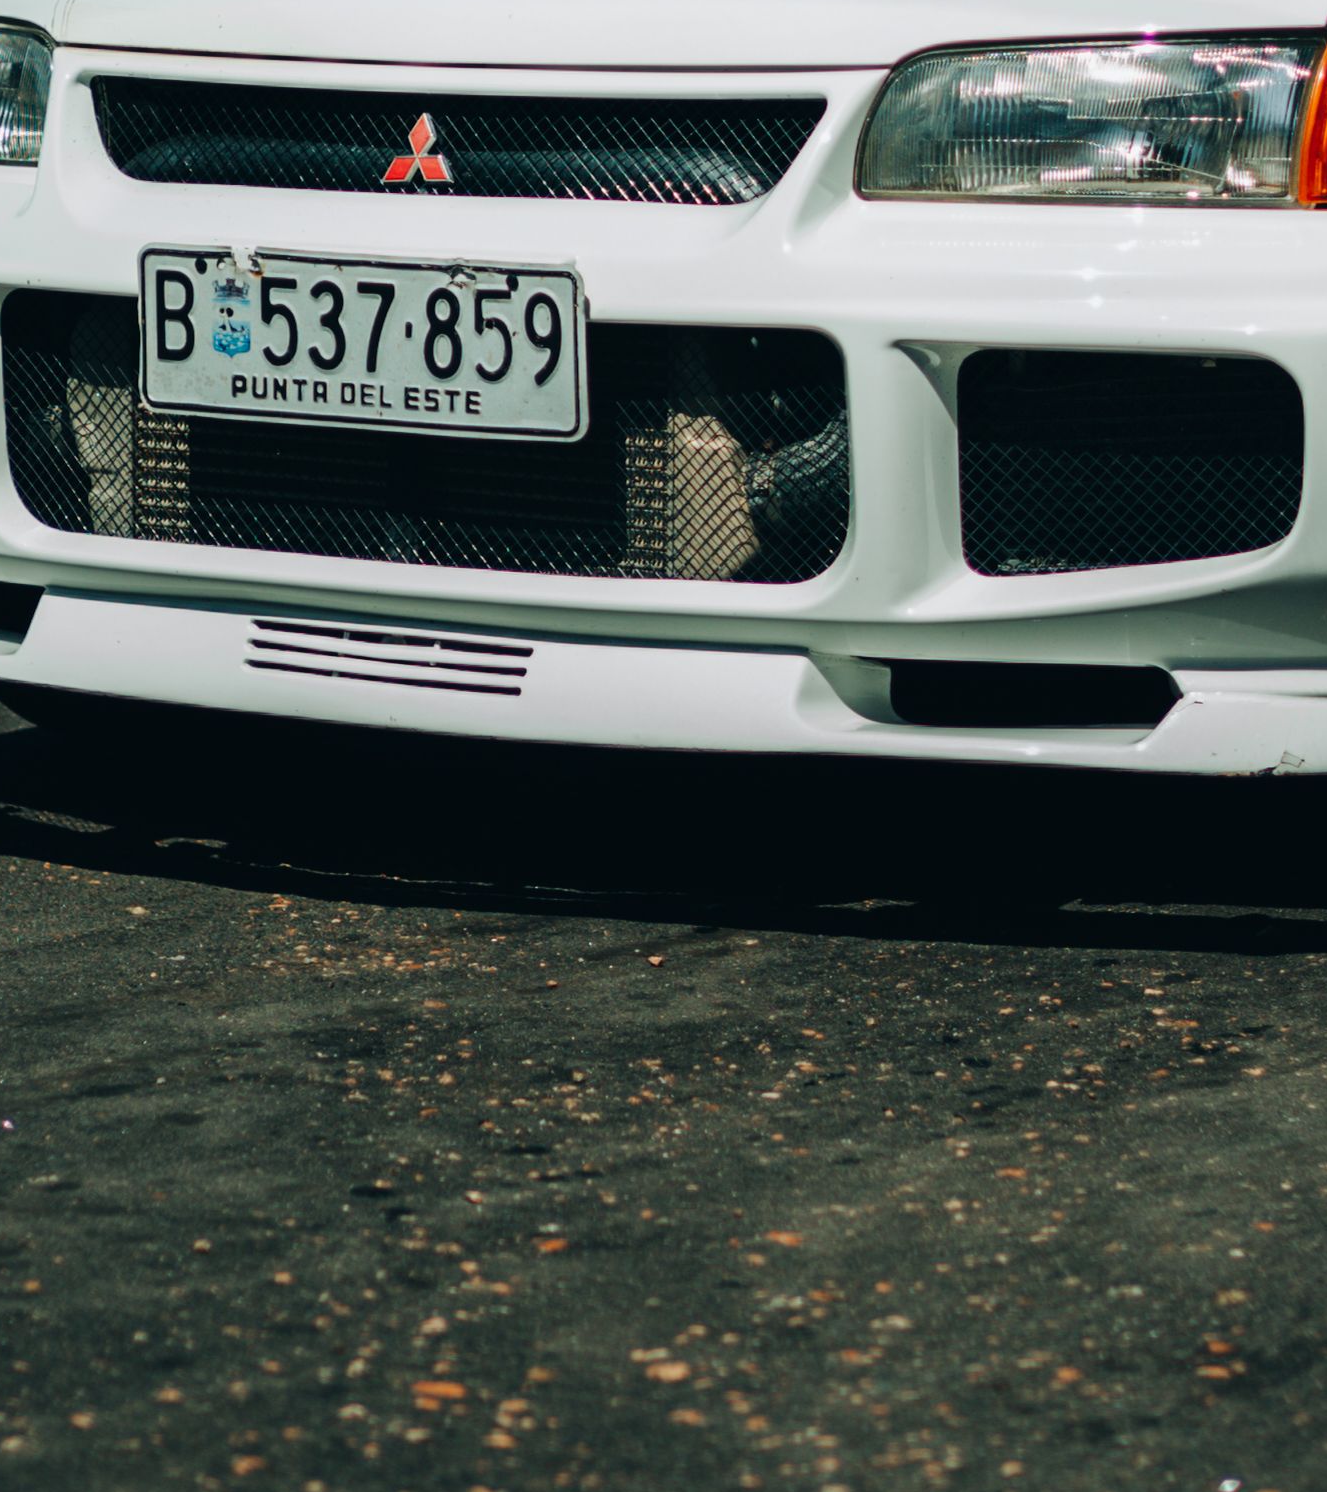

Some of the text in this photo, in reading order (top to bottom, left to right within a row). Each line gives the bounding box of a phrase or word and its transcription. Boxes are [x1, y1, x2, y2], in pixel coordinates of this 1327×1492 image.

[155, 269, 195, 362] B
[231, 374, 482, 415] PUNTA DEL ESTE
